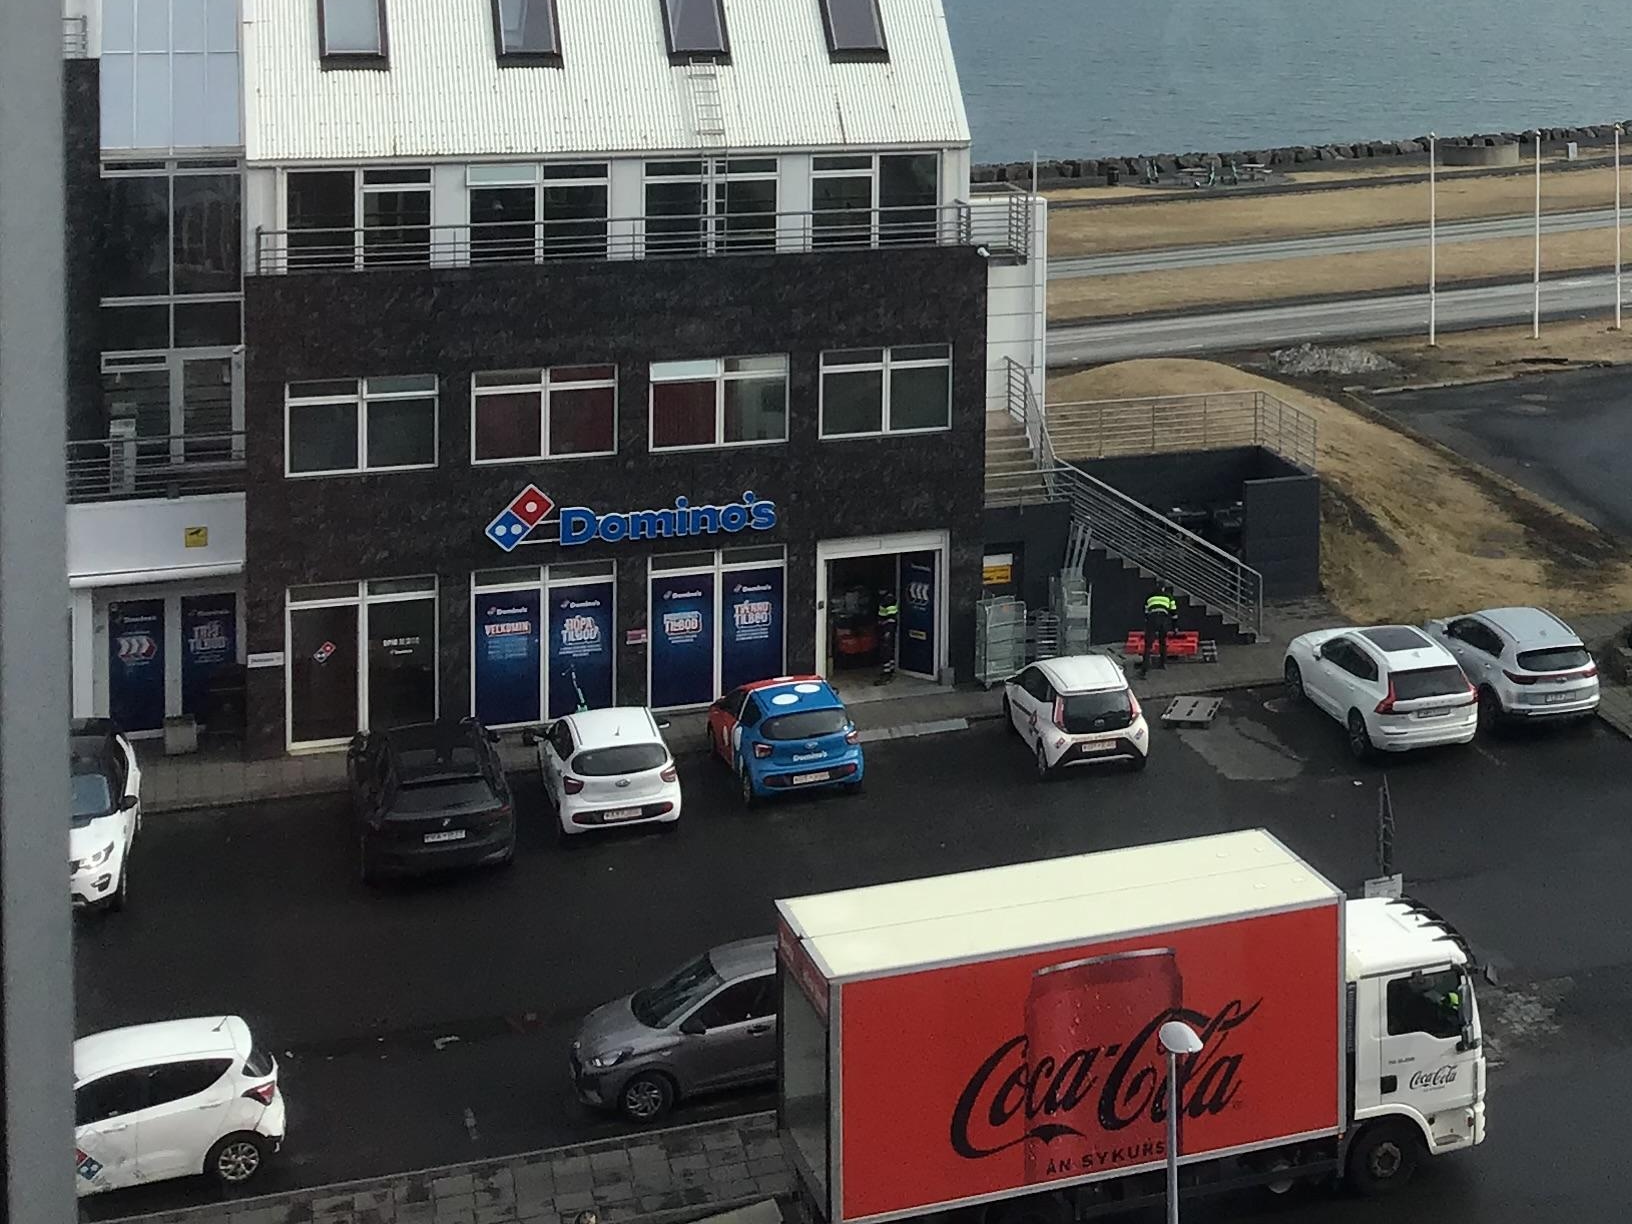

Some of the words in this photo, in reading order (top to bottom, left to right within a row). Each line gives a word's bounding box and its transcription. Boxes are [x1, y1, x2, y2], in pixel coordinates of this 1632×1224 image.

[559, 490, 777, 546] Domino's
[950, 997, 1263, 1160] Coca-Cola
[1082, 1141, 1165, 1168] SYKURS
